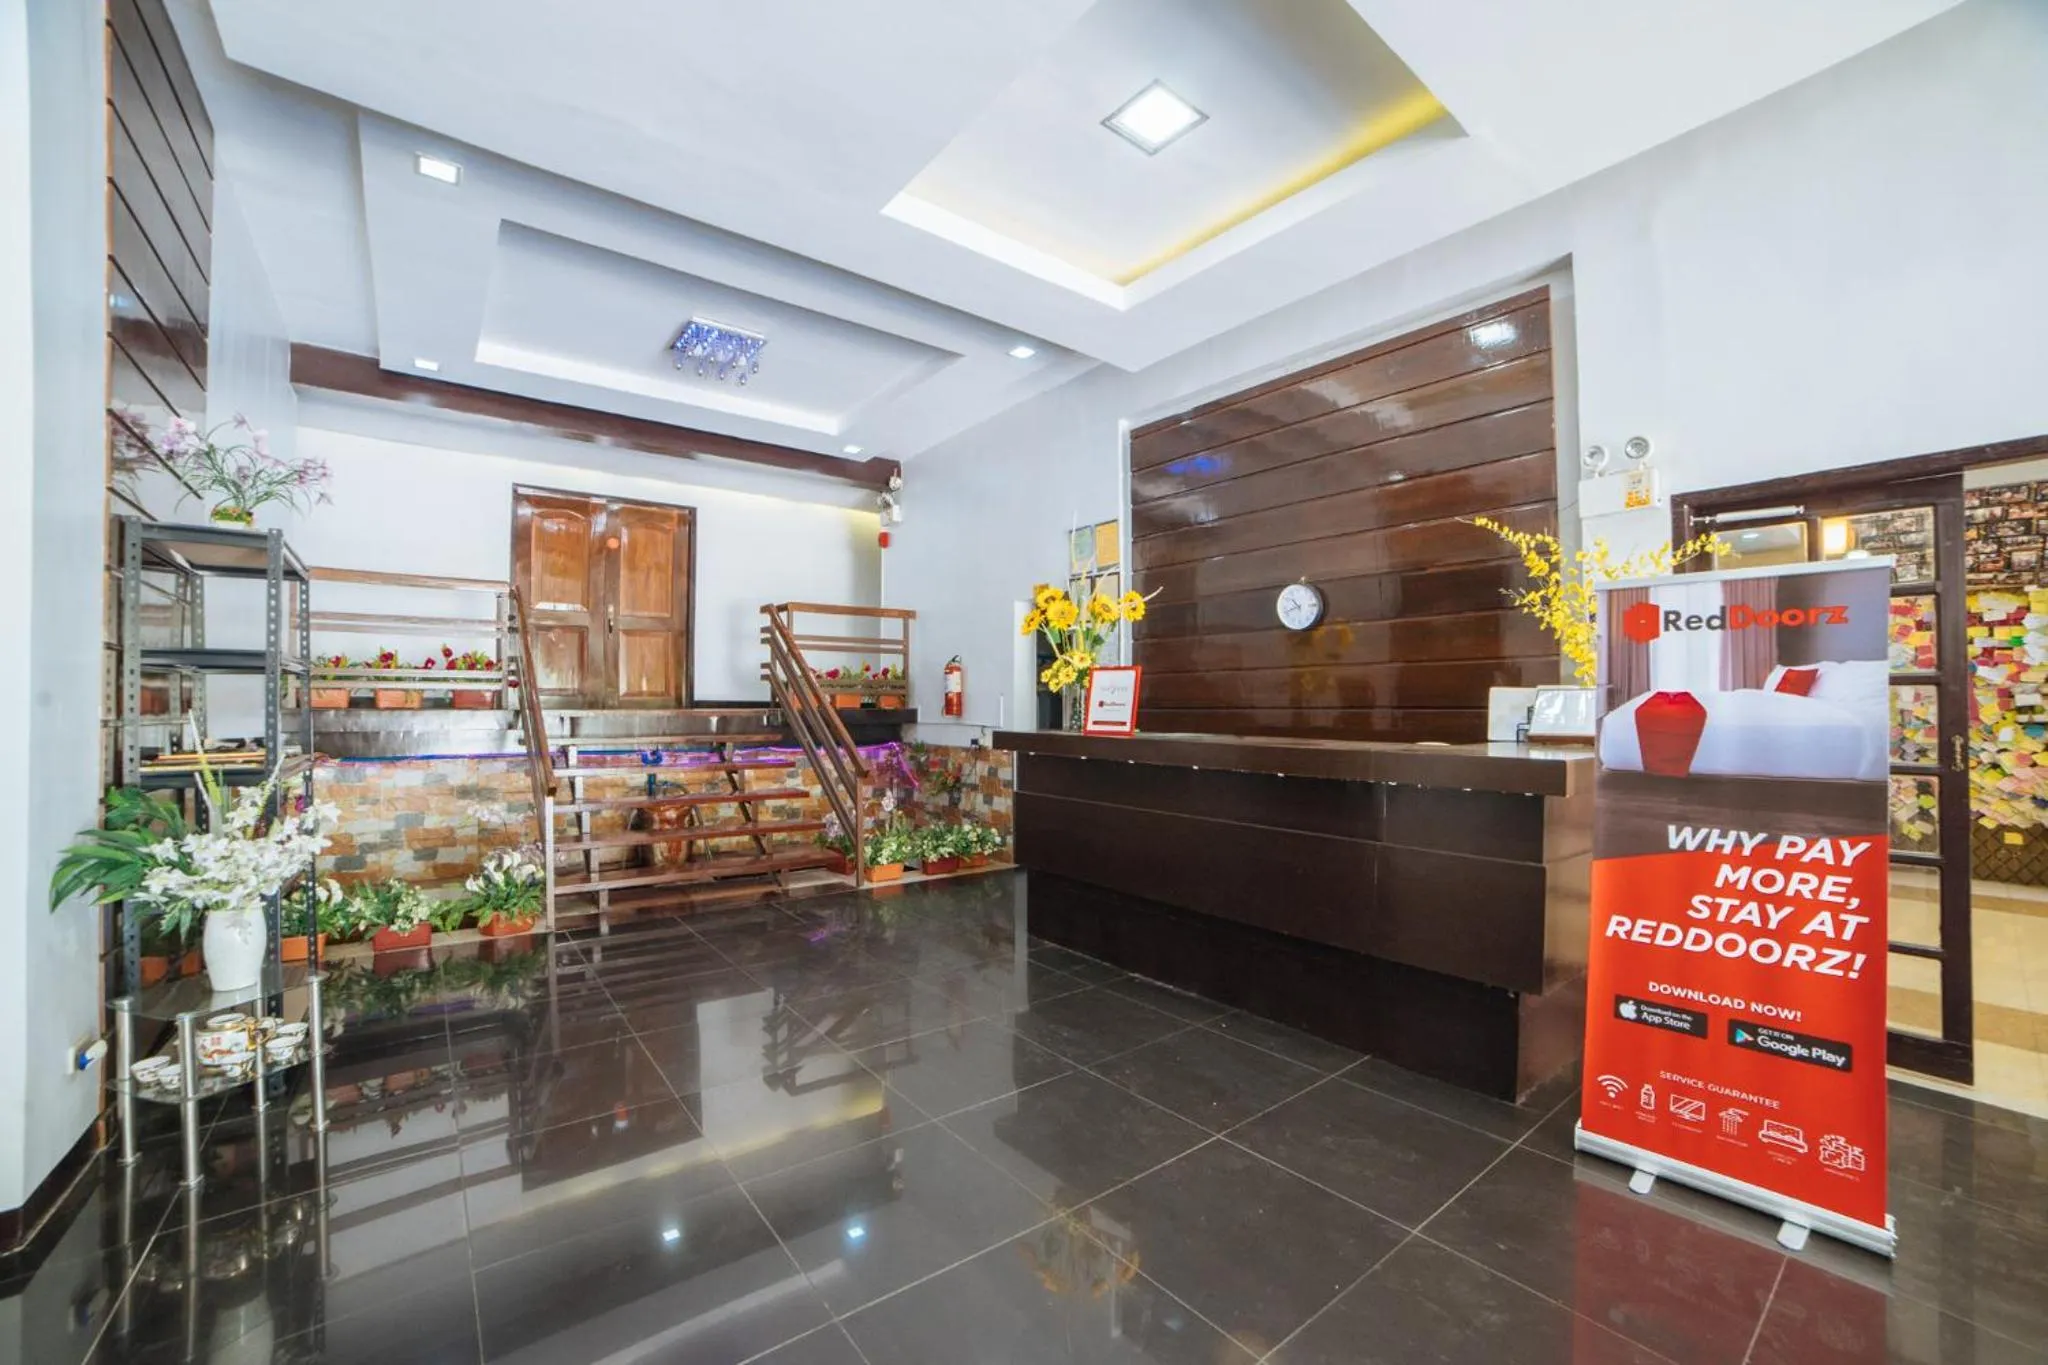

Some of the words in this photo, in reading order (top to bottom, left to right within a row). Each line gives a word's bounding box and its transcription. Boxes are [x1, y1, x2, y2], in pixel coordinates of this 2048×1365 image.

[1663, 605, 1849, 632] RedDoorz
[1667, 824, 1768, 856] WHY
[1775, 835, 1872, 867] PAY
[1714, 863, 1861, 910] MORE,
[1687, 895, 1795, 930] STAY
[1800, 910, 1870, 942] AT
[1605, 914, 1867, 980] REDDOORZ!
[1641, 1012, 1663, 1024] App
[1663, 1016, 1692, 1031] Store
[1648, 981, 1746, 1011] DOWNLOAD
[1750, 1001, 1802, 1022] NOW!
[1757, 1035, 1809, 1057] Google
[1811, 1046, 1847, 1067] Play
[1758, 1027, 1772, 1036] GET
[1659, 1070, 1706, 1090] SERVICE
[1707, 1083, 1781, 1110] GUARANTEE
